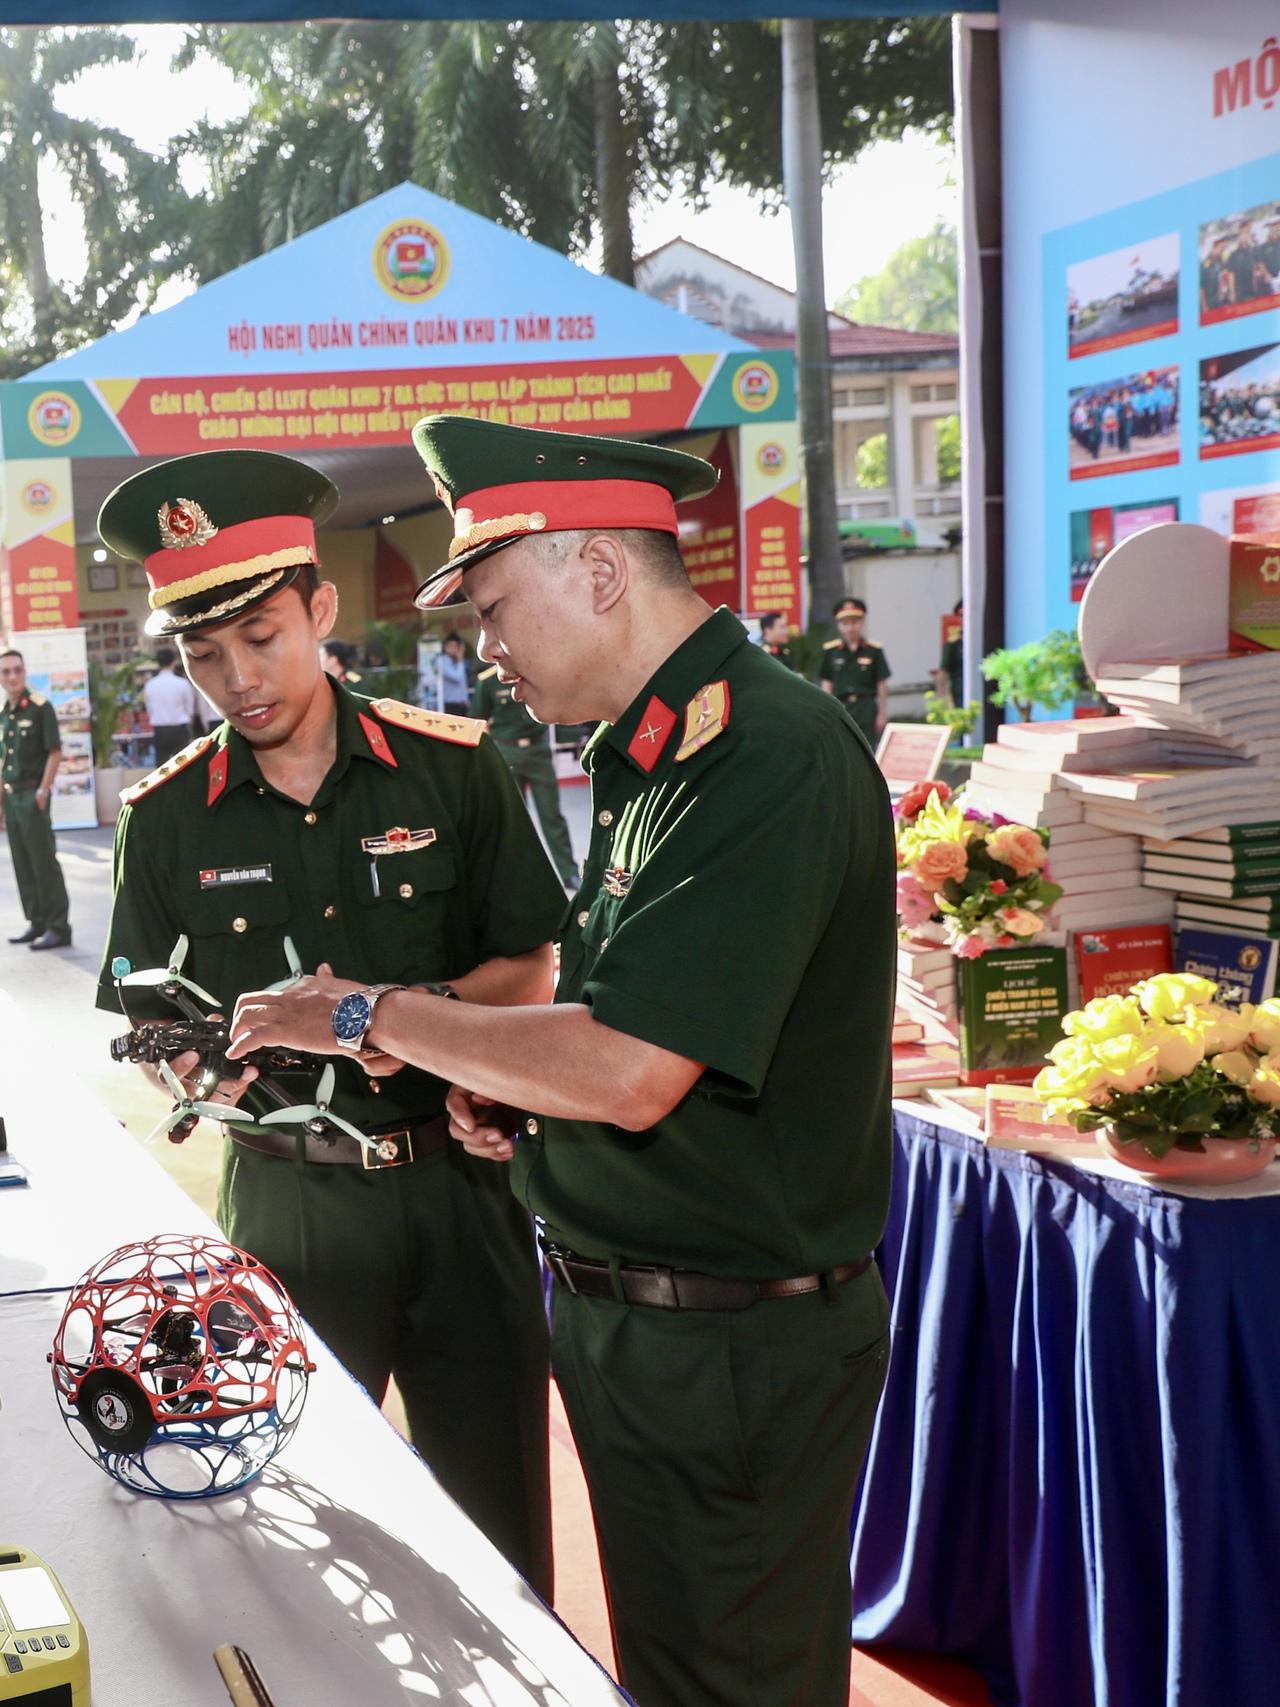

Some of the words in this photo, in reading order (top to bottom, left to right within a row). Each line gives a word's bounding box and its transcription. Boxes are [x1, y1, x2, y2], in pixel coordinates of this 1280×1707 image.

[228, 320, 257, 357] HỘI
[262, 324, 303, 355] NGHỊ
[308, 316, 352, 350] QUÂN
[358, 315, 409, 347] CHÍNH
[414, 314, 458, 345] QUÂN
[463, 318, 495, 344] KHU
[500, 318, 509, 342] 7
[515, 312, 552, 342] NĂM
[557, 315, 595, 341] 2025
[150, 391, 182, 414] CÁN
[275, 389, 307, 410] LLVT
[309, 385, 349, 410] QUÂN
[351, 387, 380, 406] KHU
[382, 386, 392, 405] 7
[394, 385, 414, 404] RA
[608, 374, 635, 393] CAO
[199, 415, 238, 439] CHÀO
[241, 414, 284, 437] MỪNG
[287, 415, 312, 439] ĐẠI
[314, 411, 338, 438] HỘI
[341, 413, 365, 437] ĐẠI
[564, 396, 591, 421] CỦA
[593, 395, 631, 418] ĐẢNG
